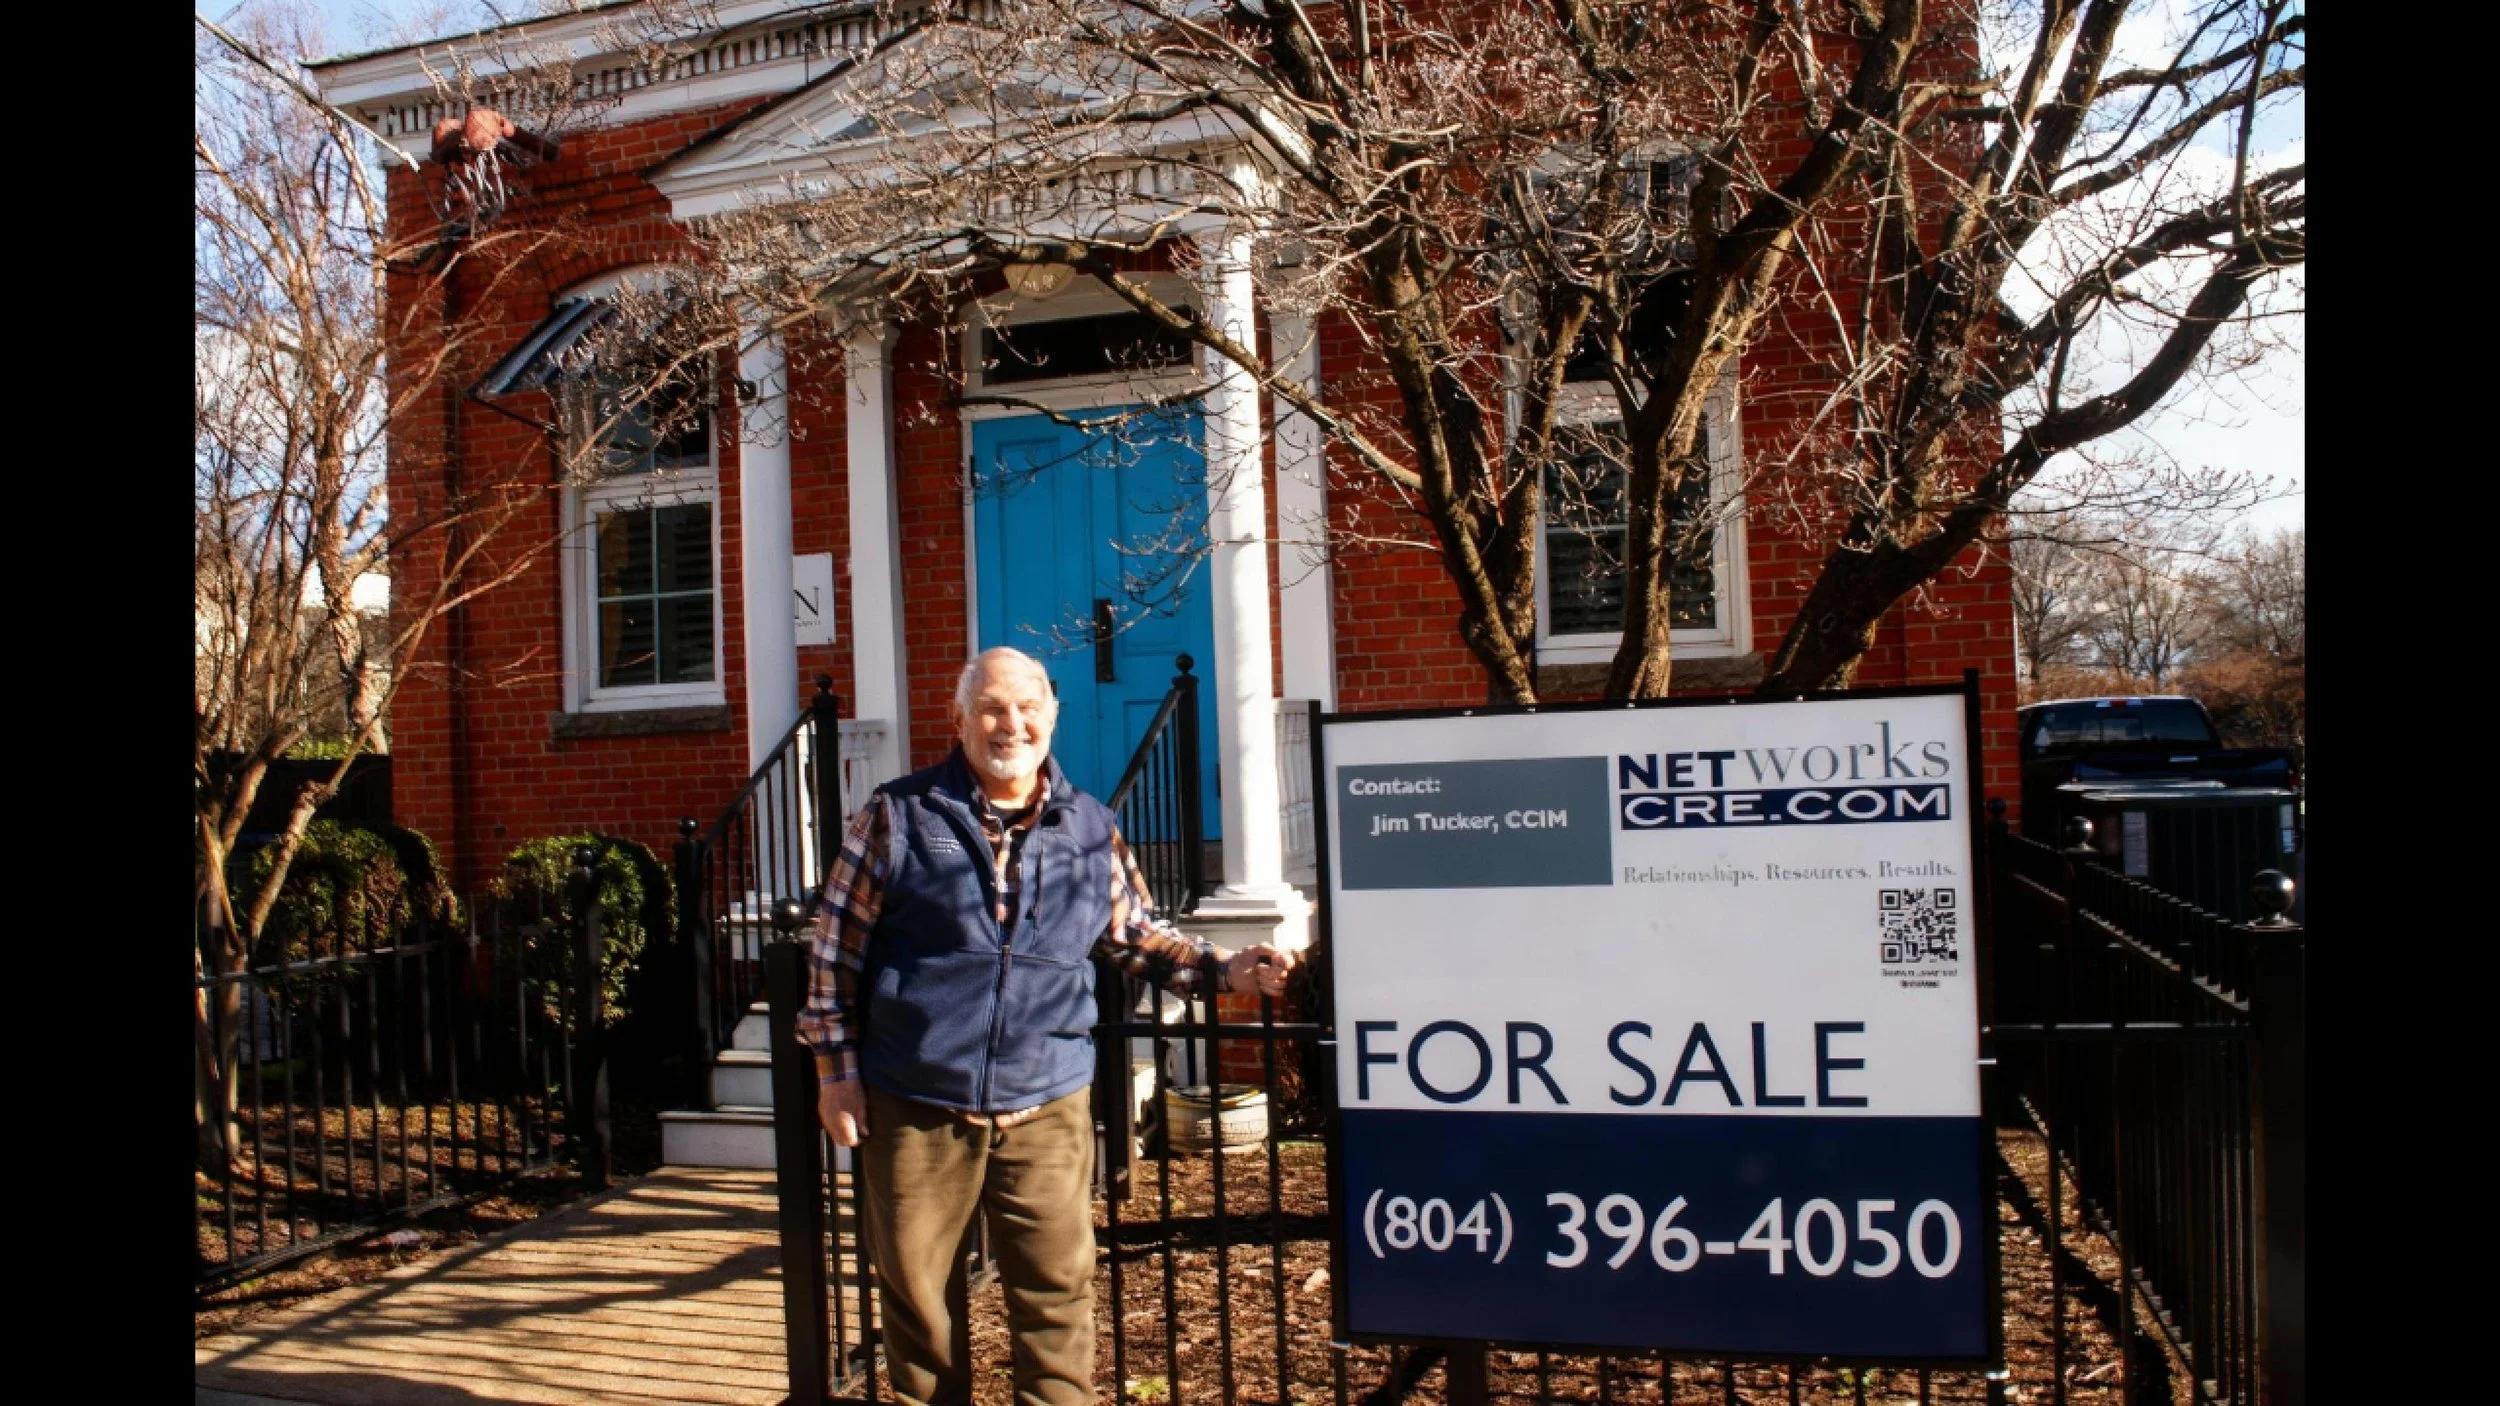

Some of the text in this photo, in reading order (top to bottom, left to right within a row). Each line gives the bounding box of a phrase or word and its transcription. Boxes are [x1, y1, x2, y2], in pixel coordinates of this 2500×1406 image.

[1349, 776, 1442, 796] Contact:
[1370, 809, 1567, 837] Jim Tucker, CCIM
[1624, 788, 1947, 826] CRE.COM
[1624, 860, 1957, 886] Relationships. Resources. Results.
[1354, 1019, 1870, 1108] FOR SALE
[1362, 1188, 1962, 1280] (804) 396-4050
